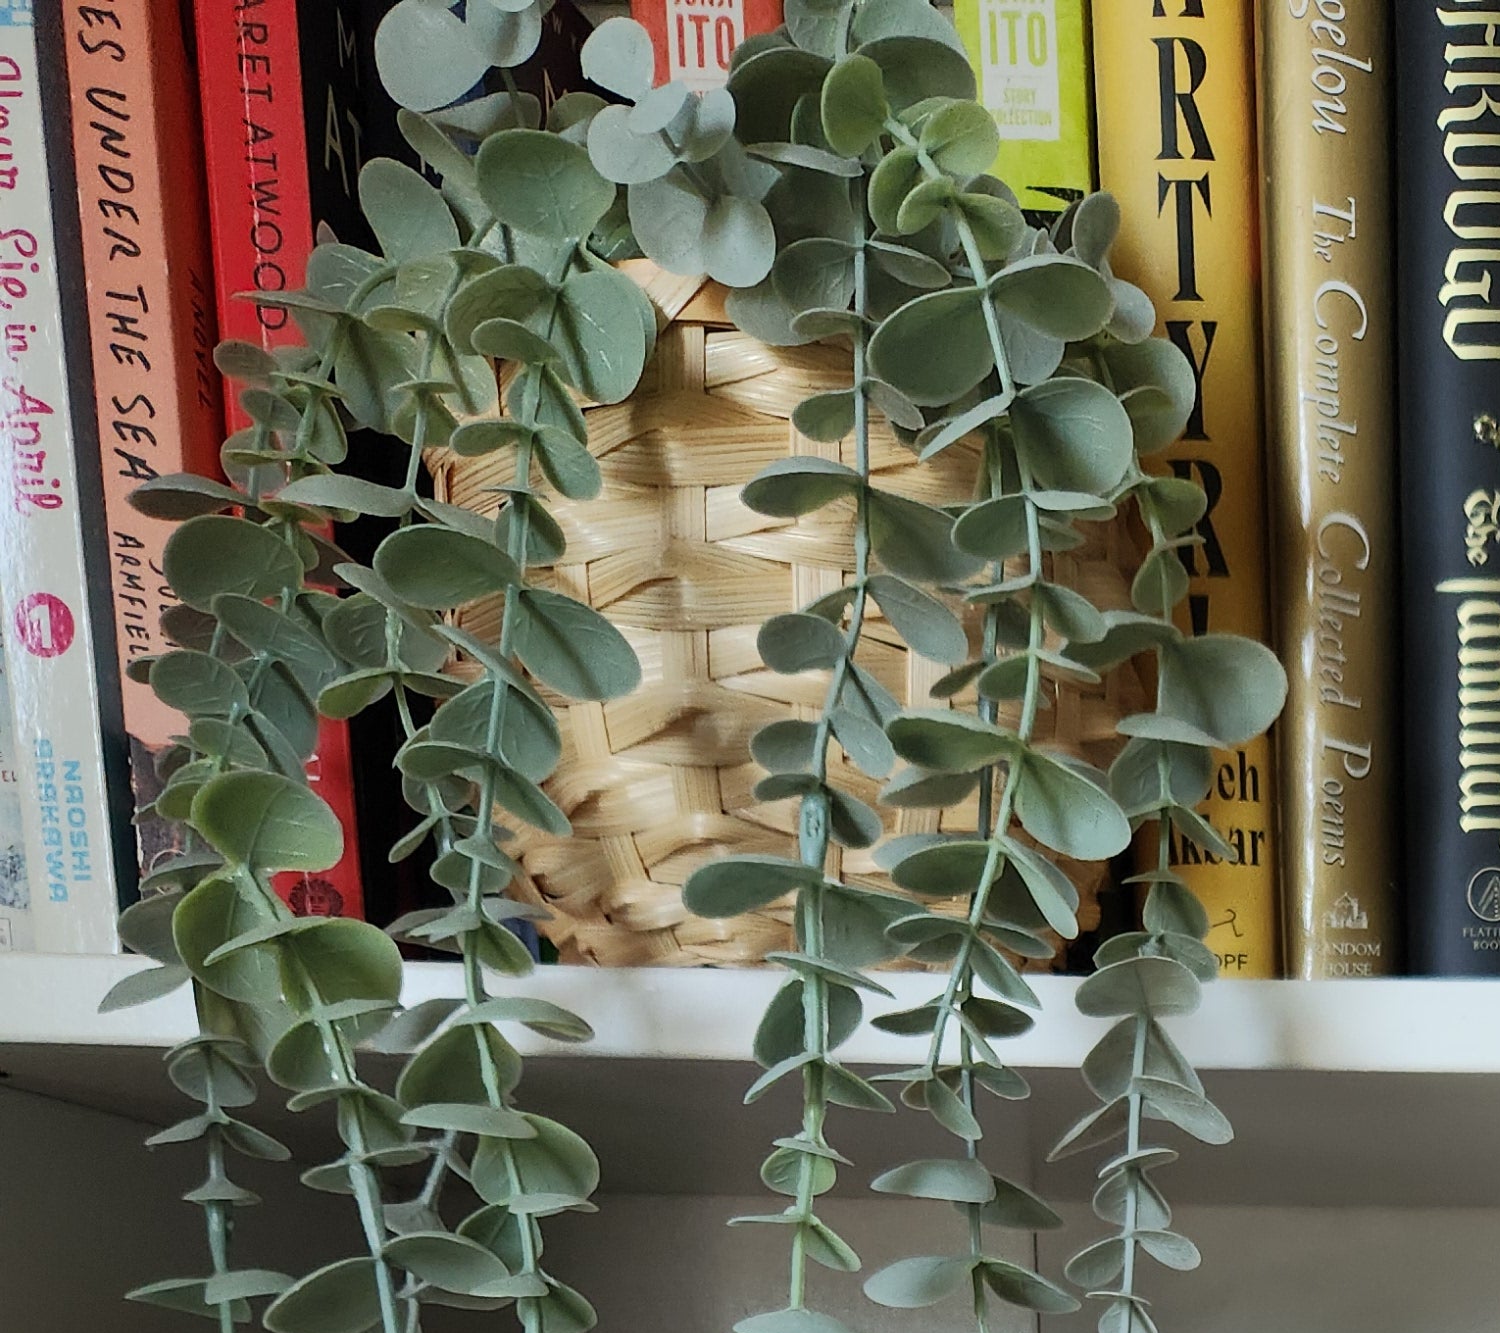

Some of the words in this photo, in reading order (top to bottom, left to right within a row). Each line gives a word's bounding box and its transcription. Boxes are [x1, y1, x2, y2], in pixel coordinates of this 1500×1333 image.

[676, 13, 737, 71] ITO
[988, 10, 1049, 67] ITO
[84, 87, 142, 263] UNDER
[242, 117, 289, 332] ATWOOD
[1311, 197, 1356, 262] The
[104, 284, 152, 372] THE
[1303, 280, 1368, 485] Complete
[110, 392, 161, 481] SEA
[1316, 511, 1371, 709] Collected
[33, 738, 69, 903] ARAKAWA
[62, 759, 92, 884] NAOSHI
[1319, 737, 1371, 866] Poems
